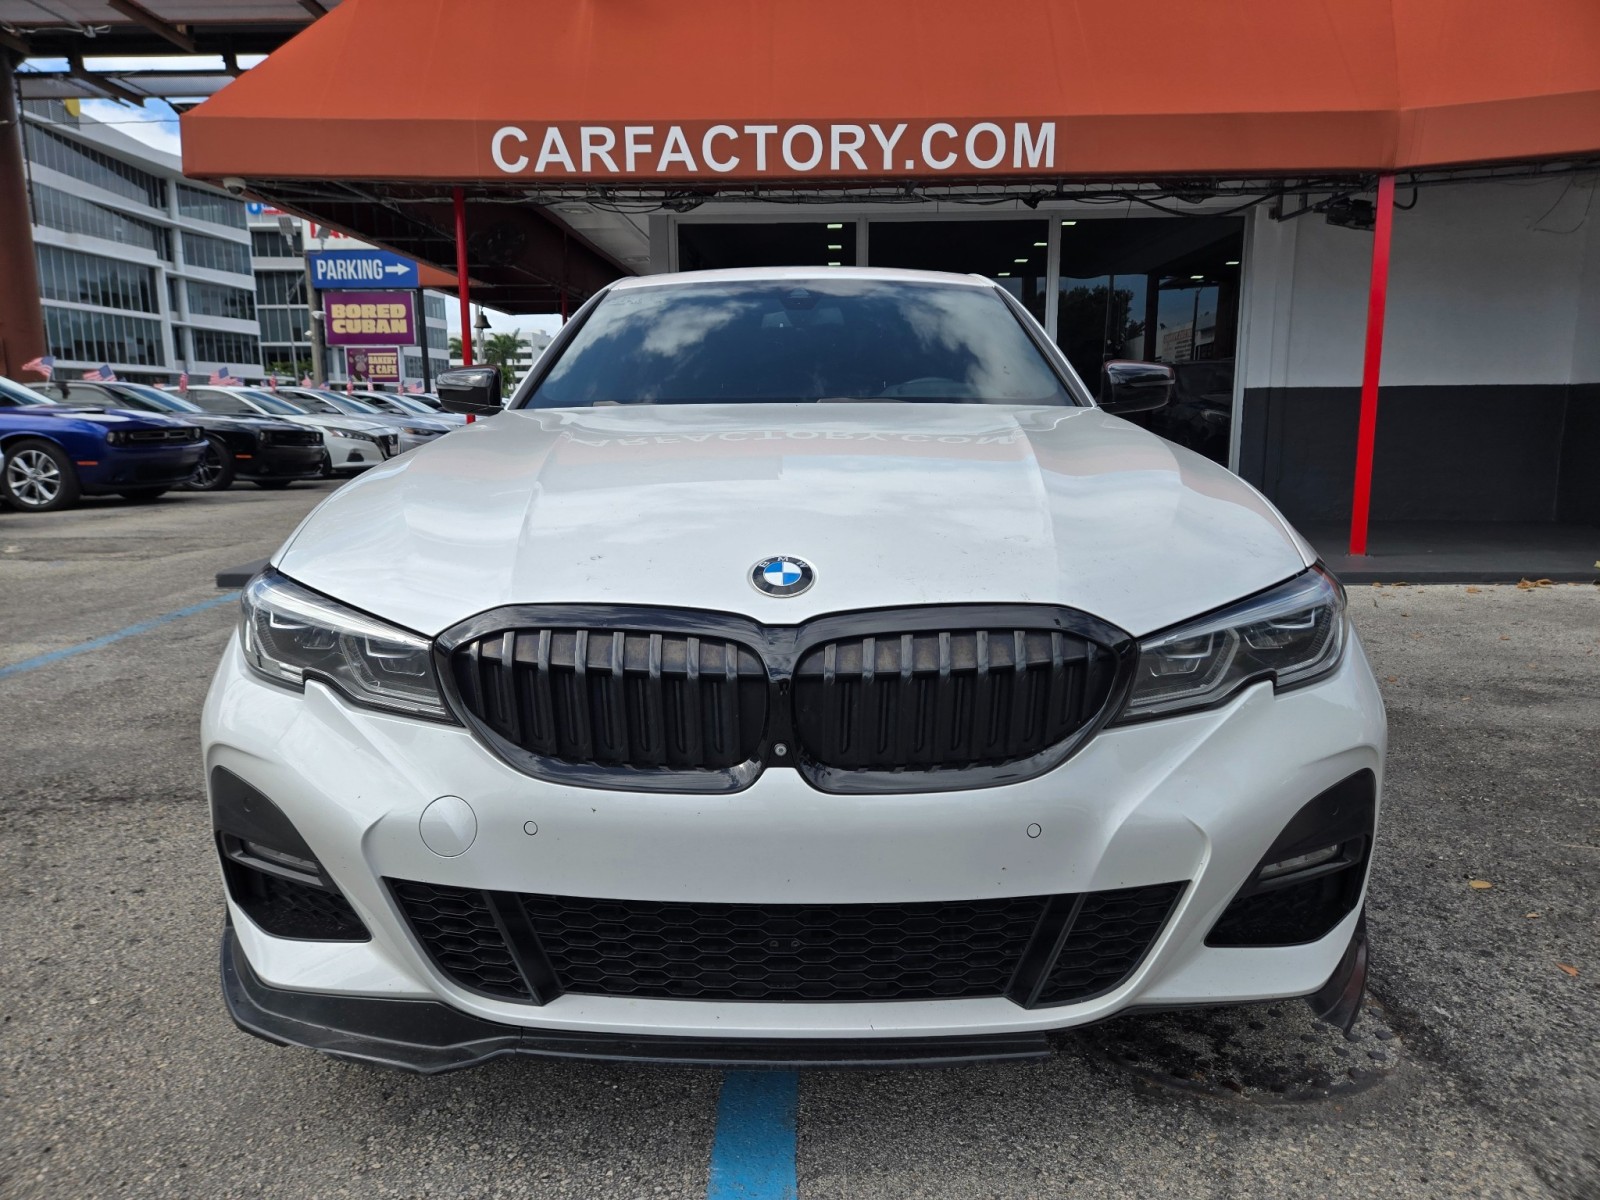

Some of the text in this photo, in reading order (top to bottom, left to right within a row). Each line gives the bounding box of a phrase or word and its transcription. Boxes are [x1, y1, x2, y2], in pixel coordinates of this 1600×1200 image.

[491, 122, 1056, 174] CARFACTORY.COM
[316, 259, 384, 280] PARKING
[331, 304, 406, 319] BORED
[332, 319, 407, 334] CUBAN
[368, 356, 397, 365] BAKERY
[759, 556, 809, 568] BMW
